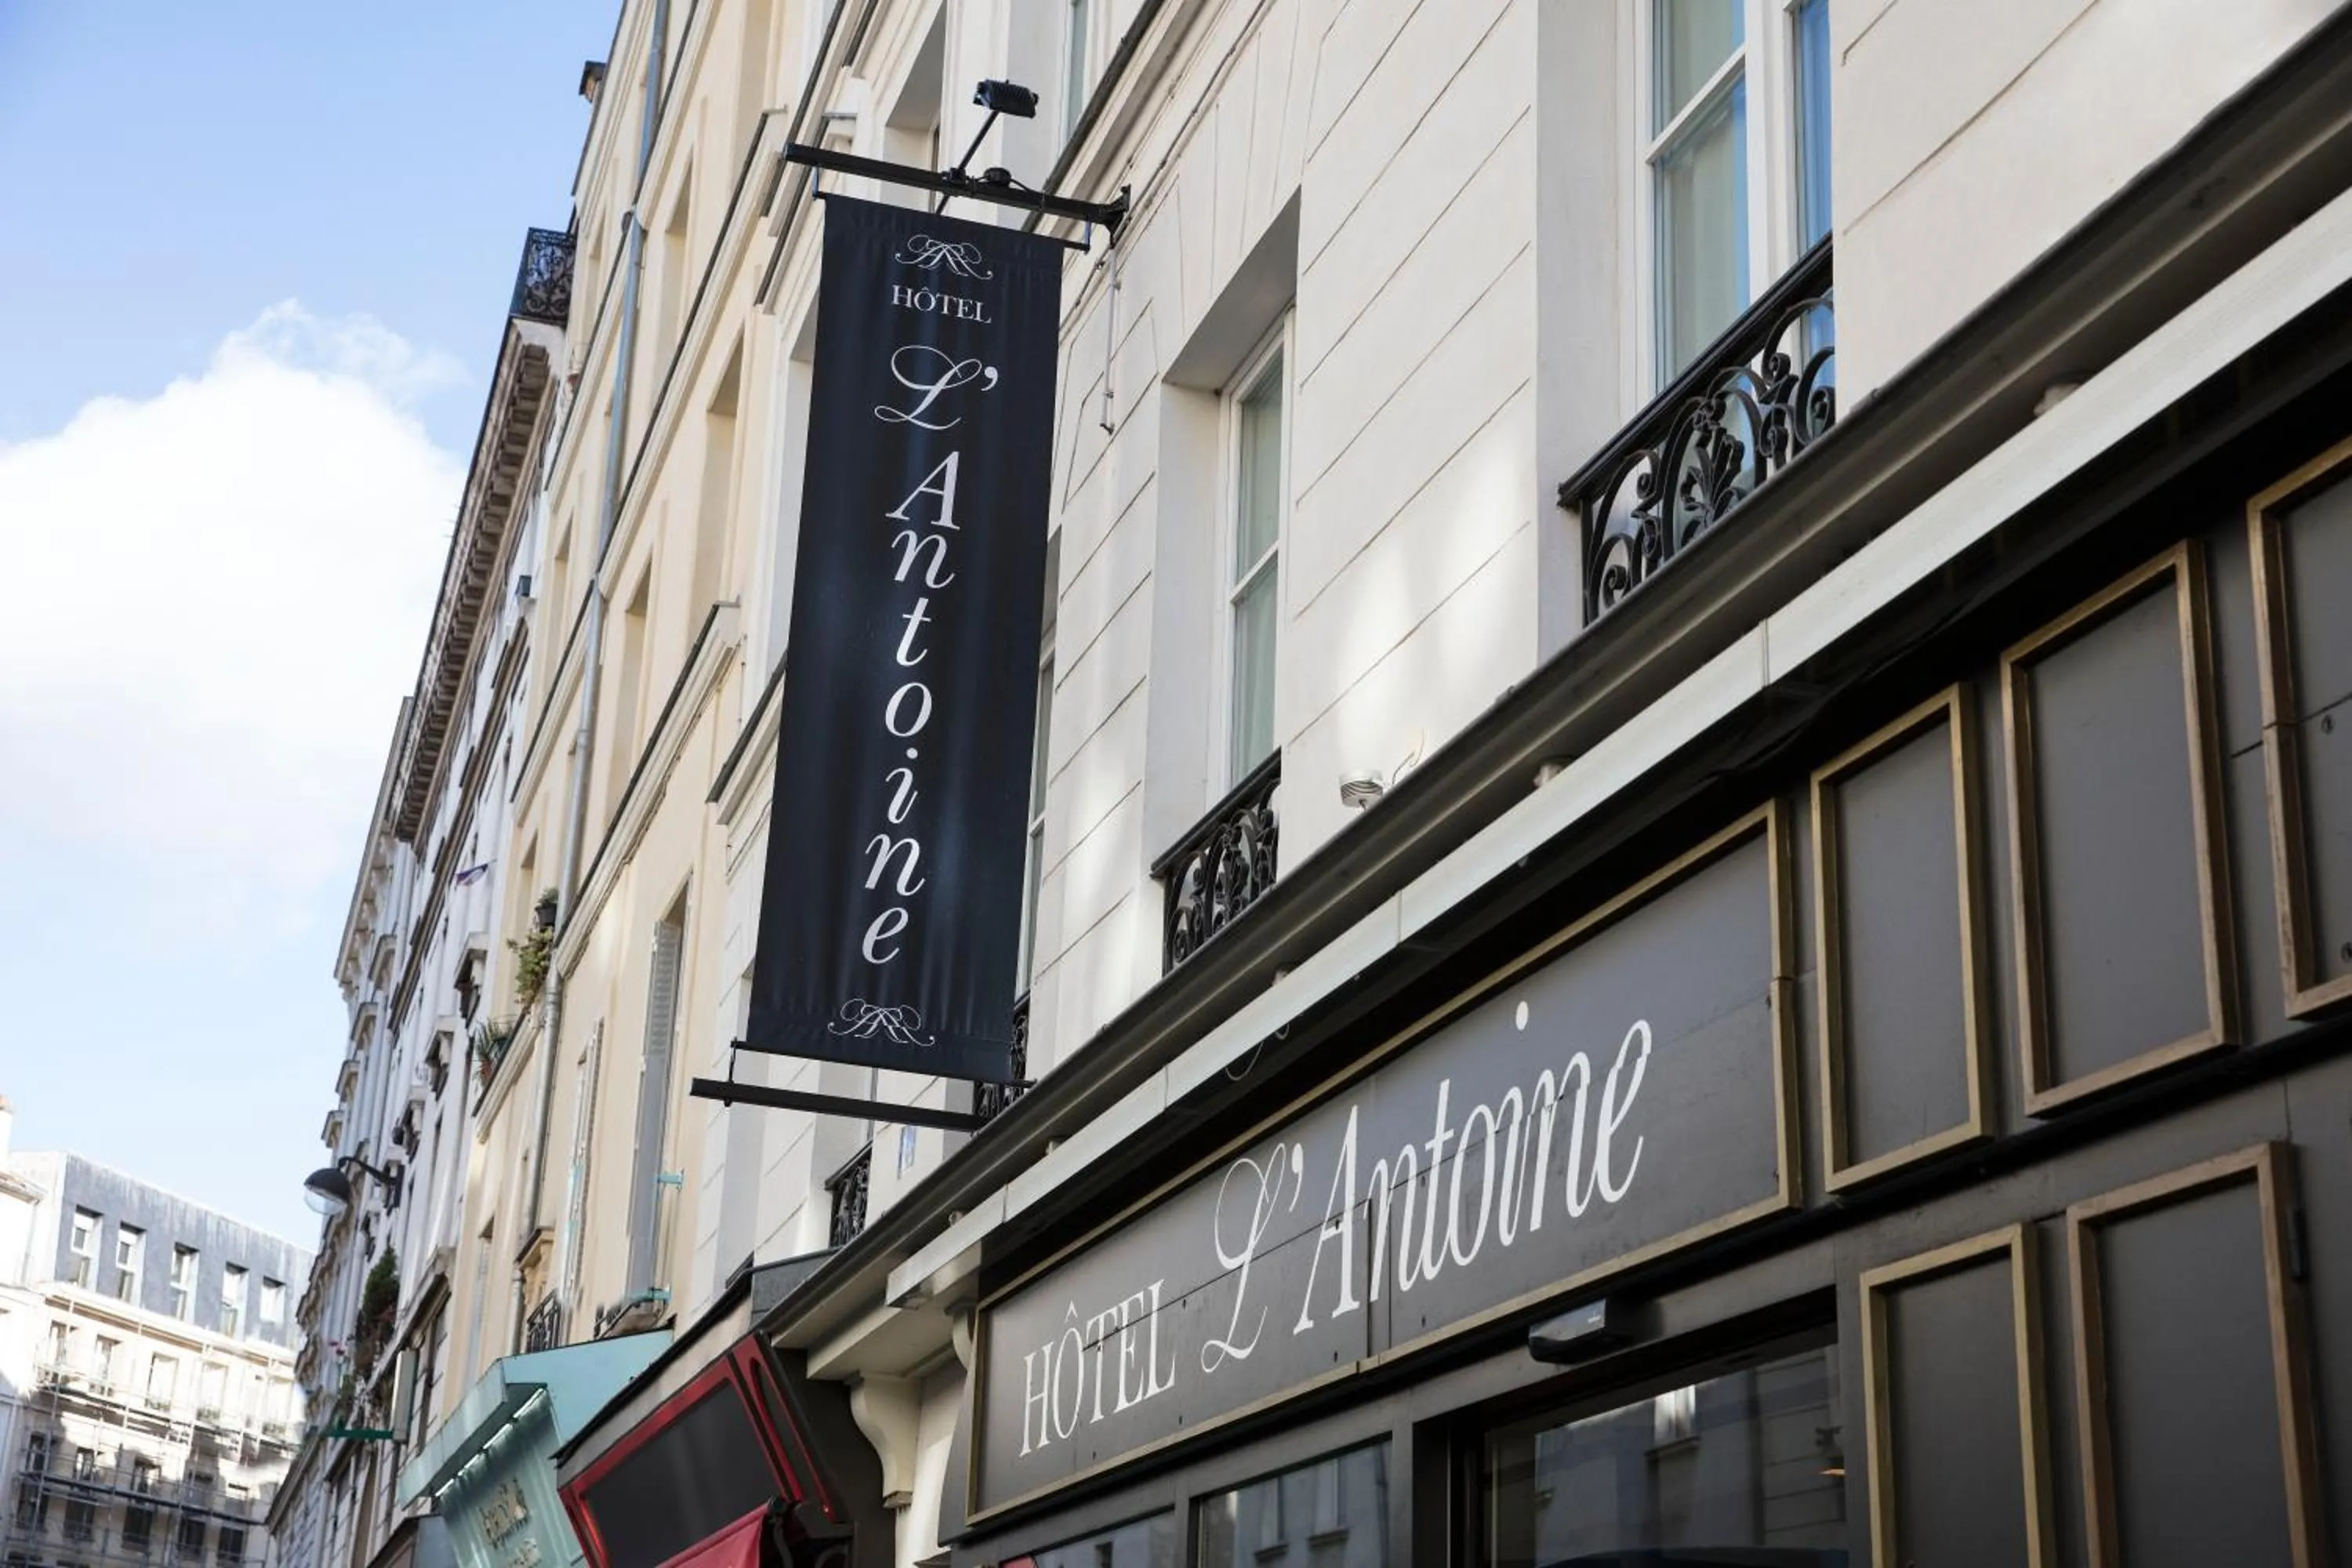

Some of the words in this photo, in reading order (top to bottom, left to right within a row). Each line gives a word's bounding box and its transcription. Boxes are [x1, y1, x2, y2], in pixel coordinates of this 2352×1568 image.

[892, 285, 992, 324] HÔTEL
[1018, 1279, 1176, 1457] HÔTEL
[1200, 1000, 1652, 1374] L'Antoine
